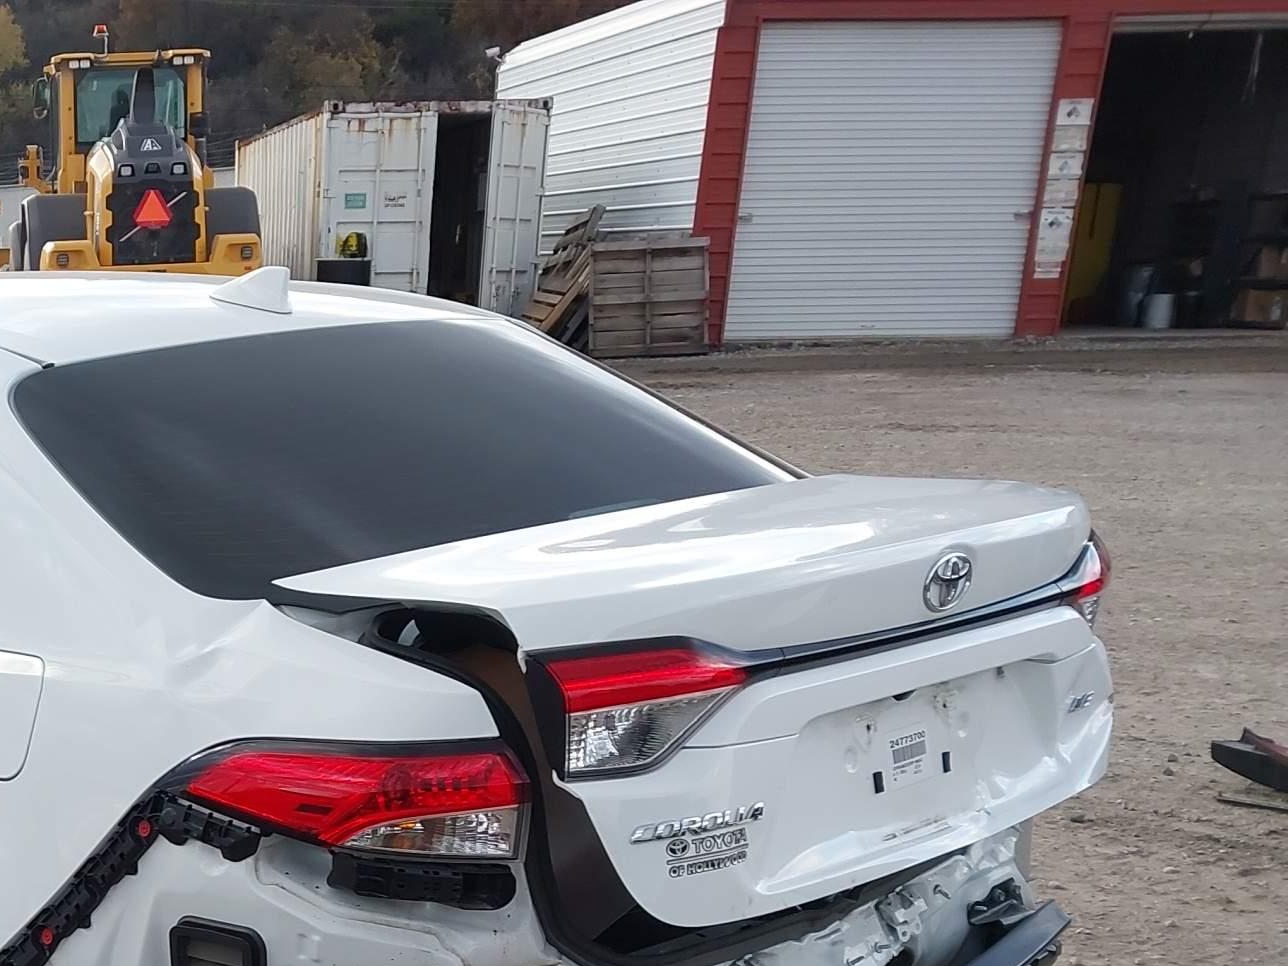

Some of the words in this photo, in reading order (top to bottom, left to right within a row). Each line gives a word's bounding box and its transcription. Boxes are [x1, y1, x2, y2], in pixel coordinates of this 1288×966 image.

[889, 730, 926, 749] 24773700
[630, 801, 765, 845] COROLLA
[692, 827, 748, 854] TOYOTA
[668, 864, 686, 879] OF
[686, 850, 748, 876] HOLLYWOOD
